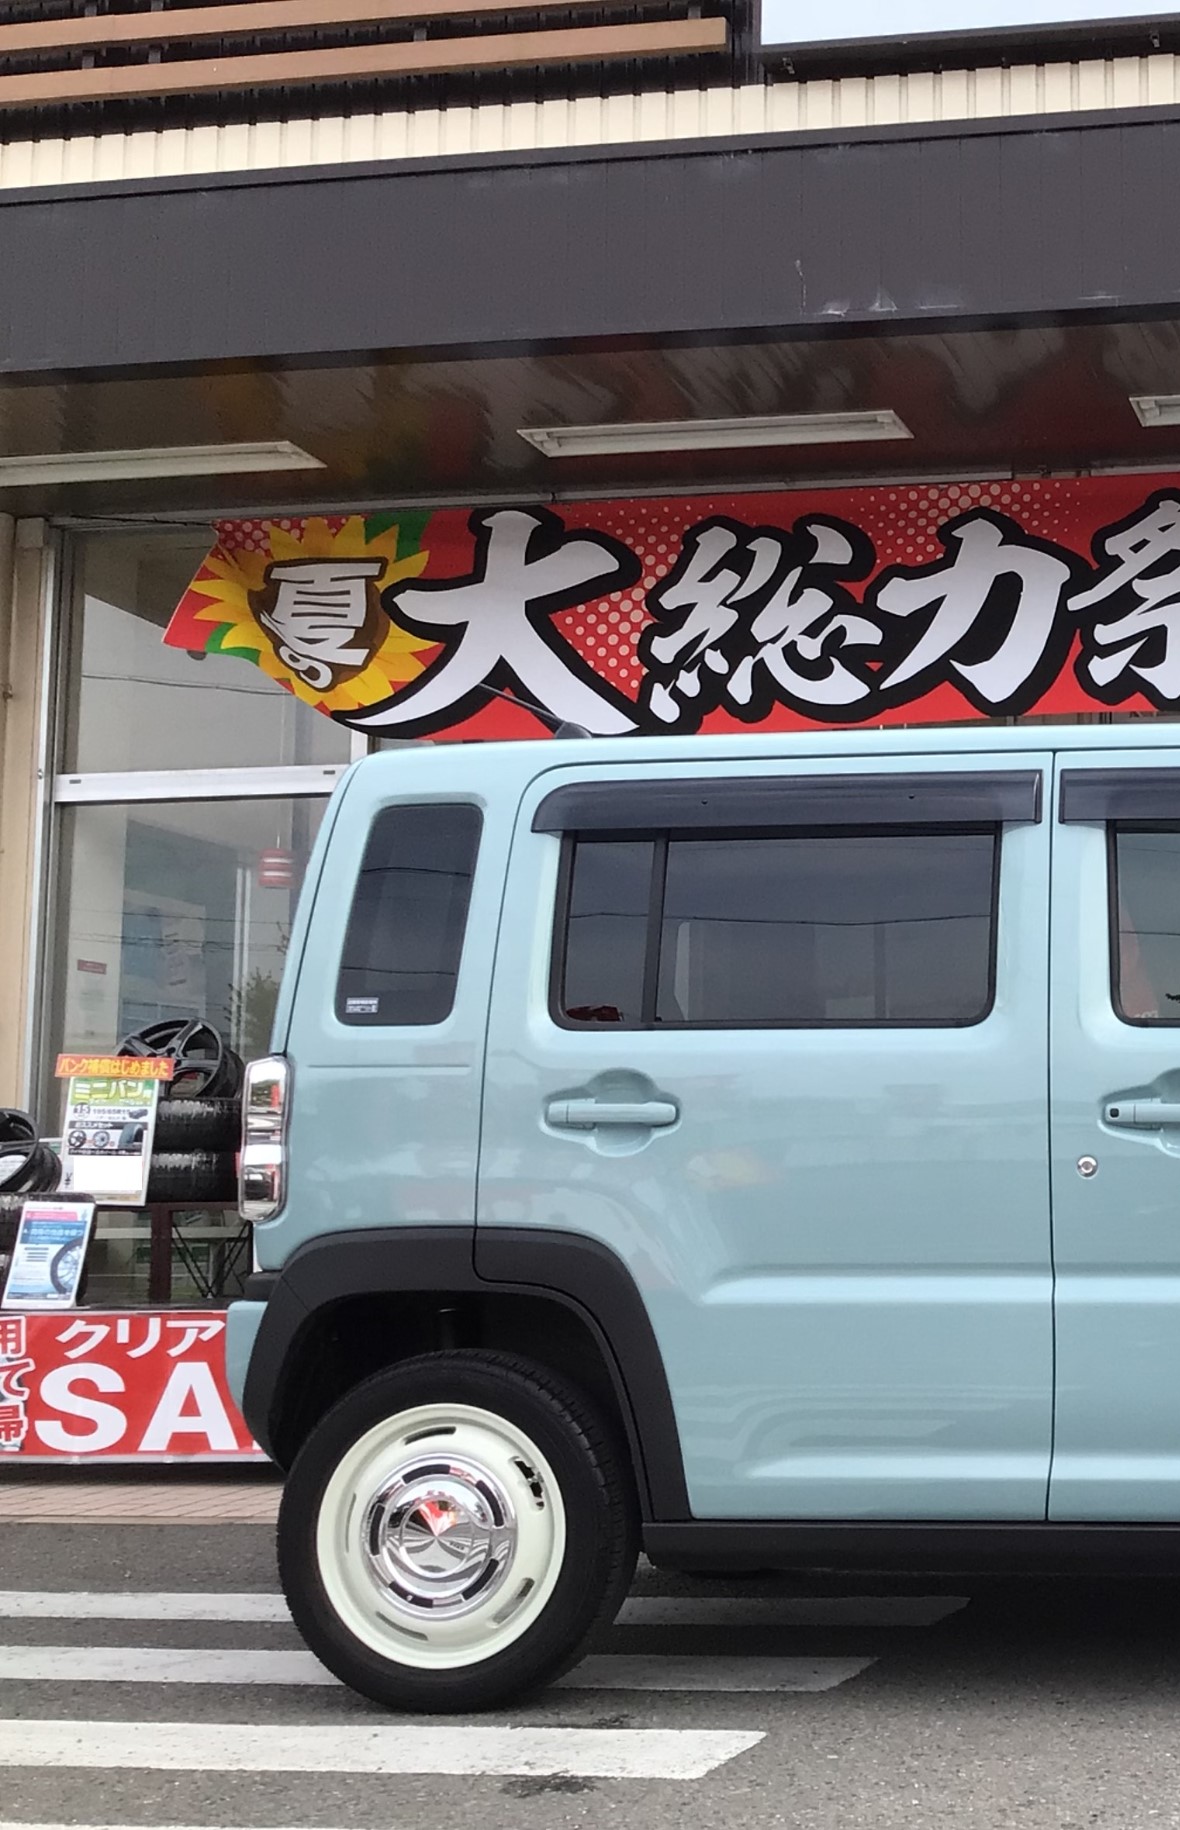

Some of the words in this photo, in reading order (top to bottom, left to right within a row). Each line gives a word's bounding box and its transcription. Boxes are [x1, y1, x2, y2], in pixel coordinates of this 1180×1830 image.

[55, 1318, 226, 1359] クリア
[34, 1361, 240, 1453] SA
